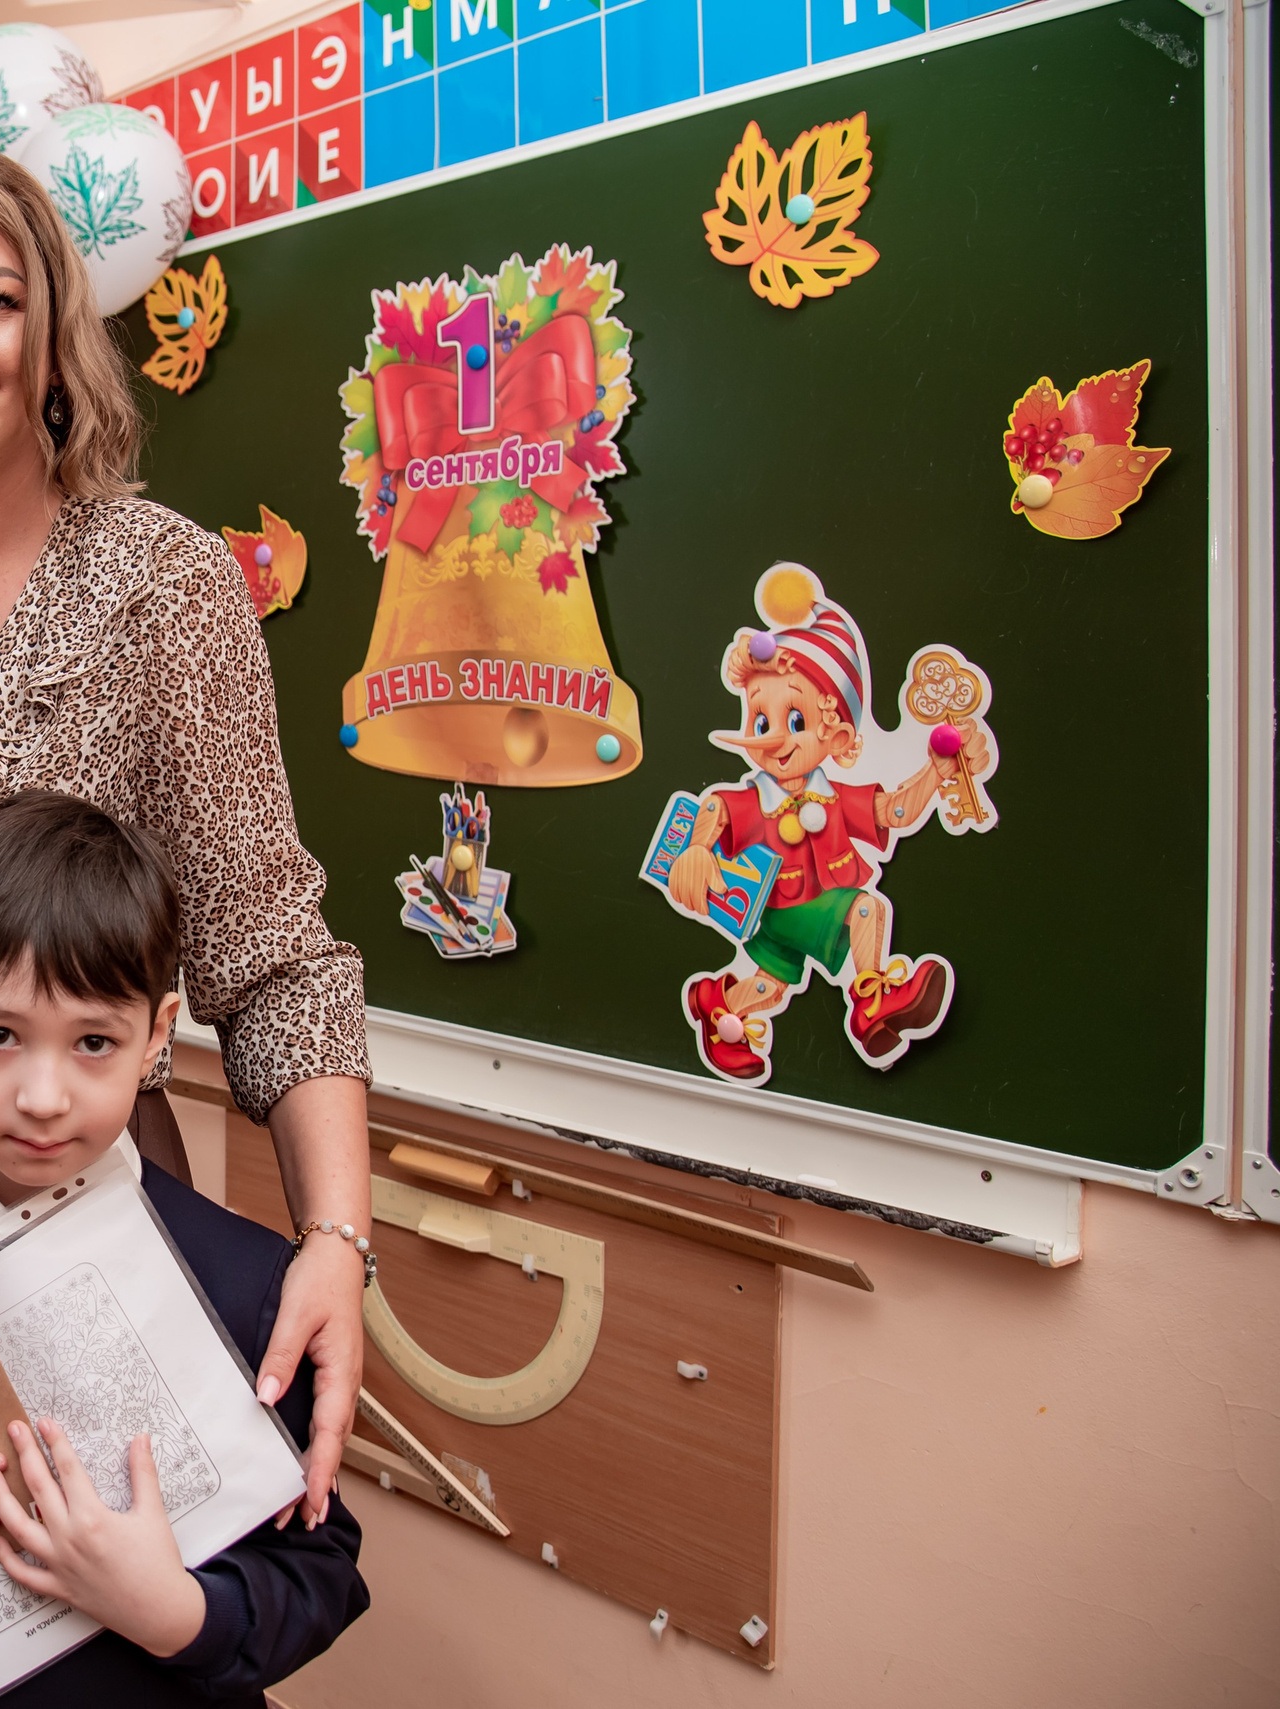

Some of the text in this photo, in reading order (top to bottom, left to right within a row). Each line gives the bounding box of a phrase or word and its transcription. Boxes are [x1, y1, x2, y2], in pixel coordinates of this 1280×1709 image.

[190, 80, 220, 134] У
[246, 56, 282, 117] Ы
[311, 35, 348, 91] Э
[382, 5, 414, 68] Н
[248, 147, 280, 204] И
[317, 127, 340, 183] Е
[438, 293, 494, 433] 1
[406, 436, 562, 490] сентября
[365, 659, 612, 720] ДЕНЬ ЗНАНИЙ
[650, 802, 695, 878] АЗБУКА
[24, 1605, 73, 1638] РАСКРАСЬ ИХ
